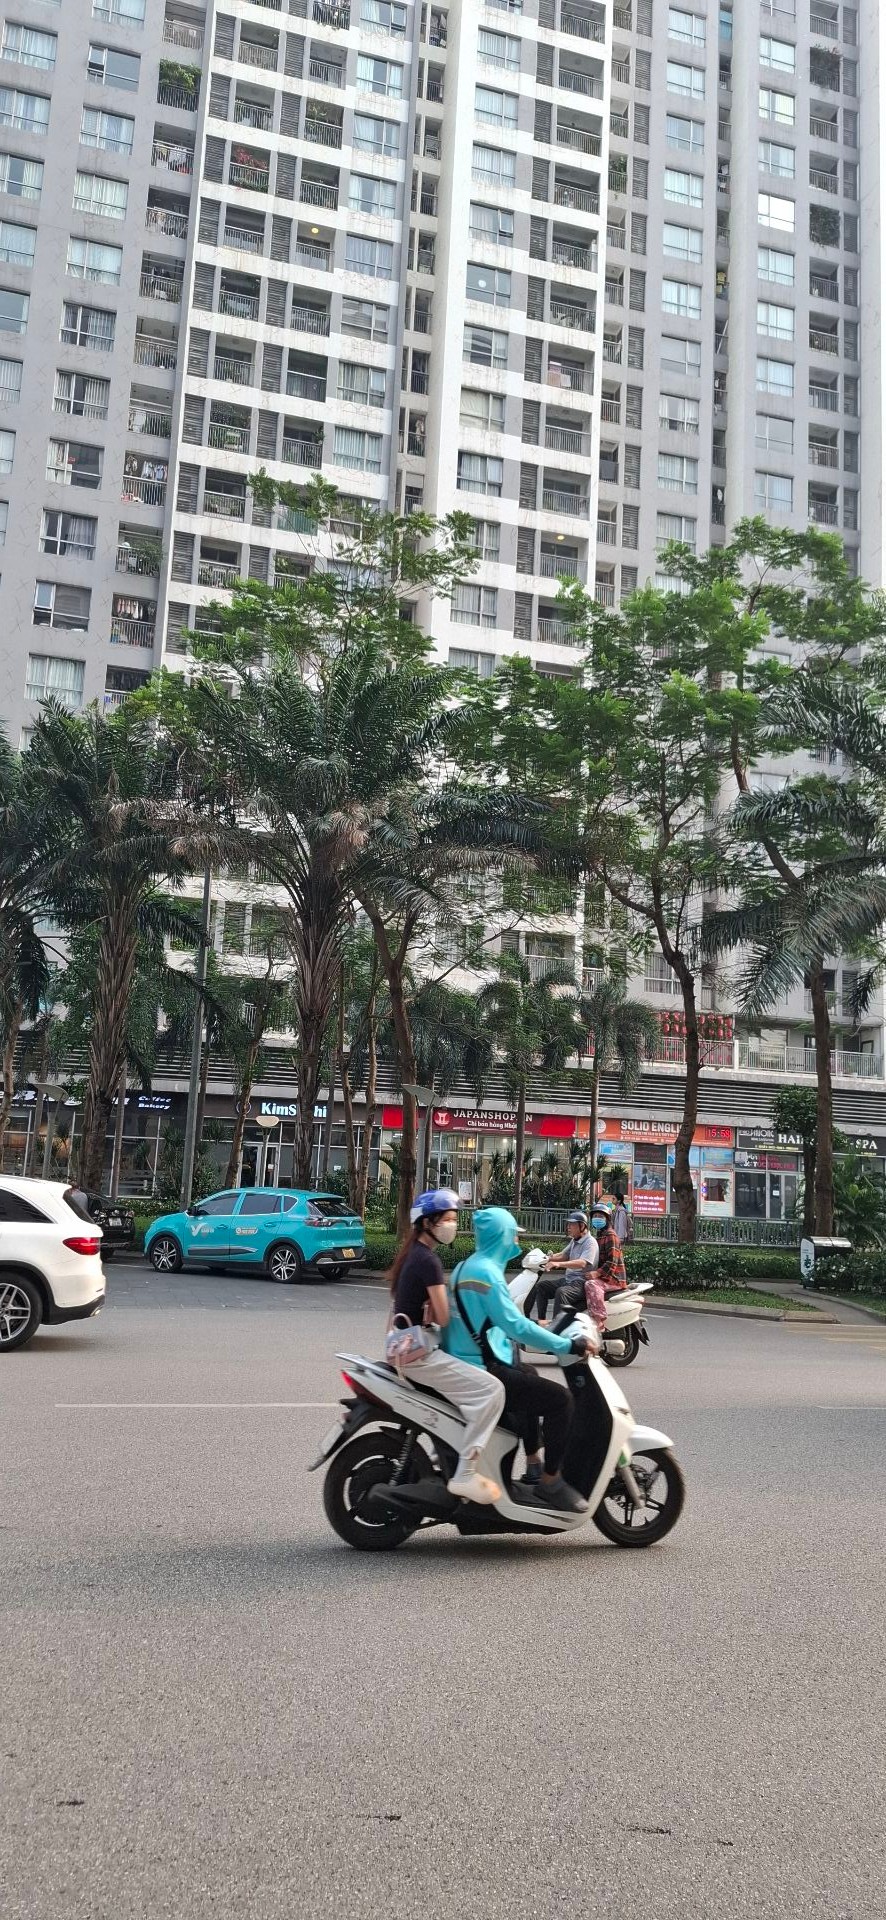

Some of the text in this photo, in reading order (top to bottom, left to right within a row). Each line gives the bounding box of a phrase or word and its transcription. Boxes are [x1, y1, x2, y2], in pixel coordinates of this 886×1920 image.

[261, 1102, 327, 1118] KimShi
[453, 1109, 533, 1122] JAPANSHOP.N
[620, 1120, 682, 1133] SOLID ENGLI
